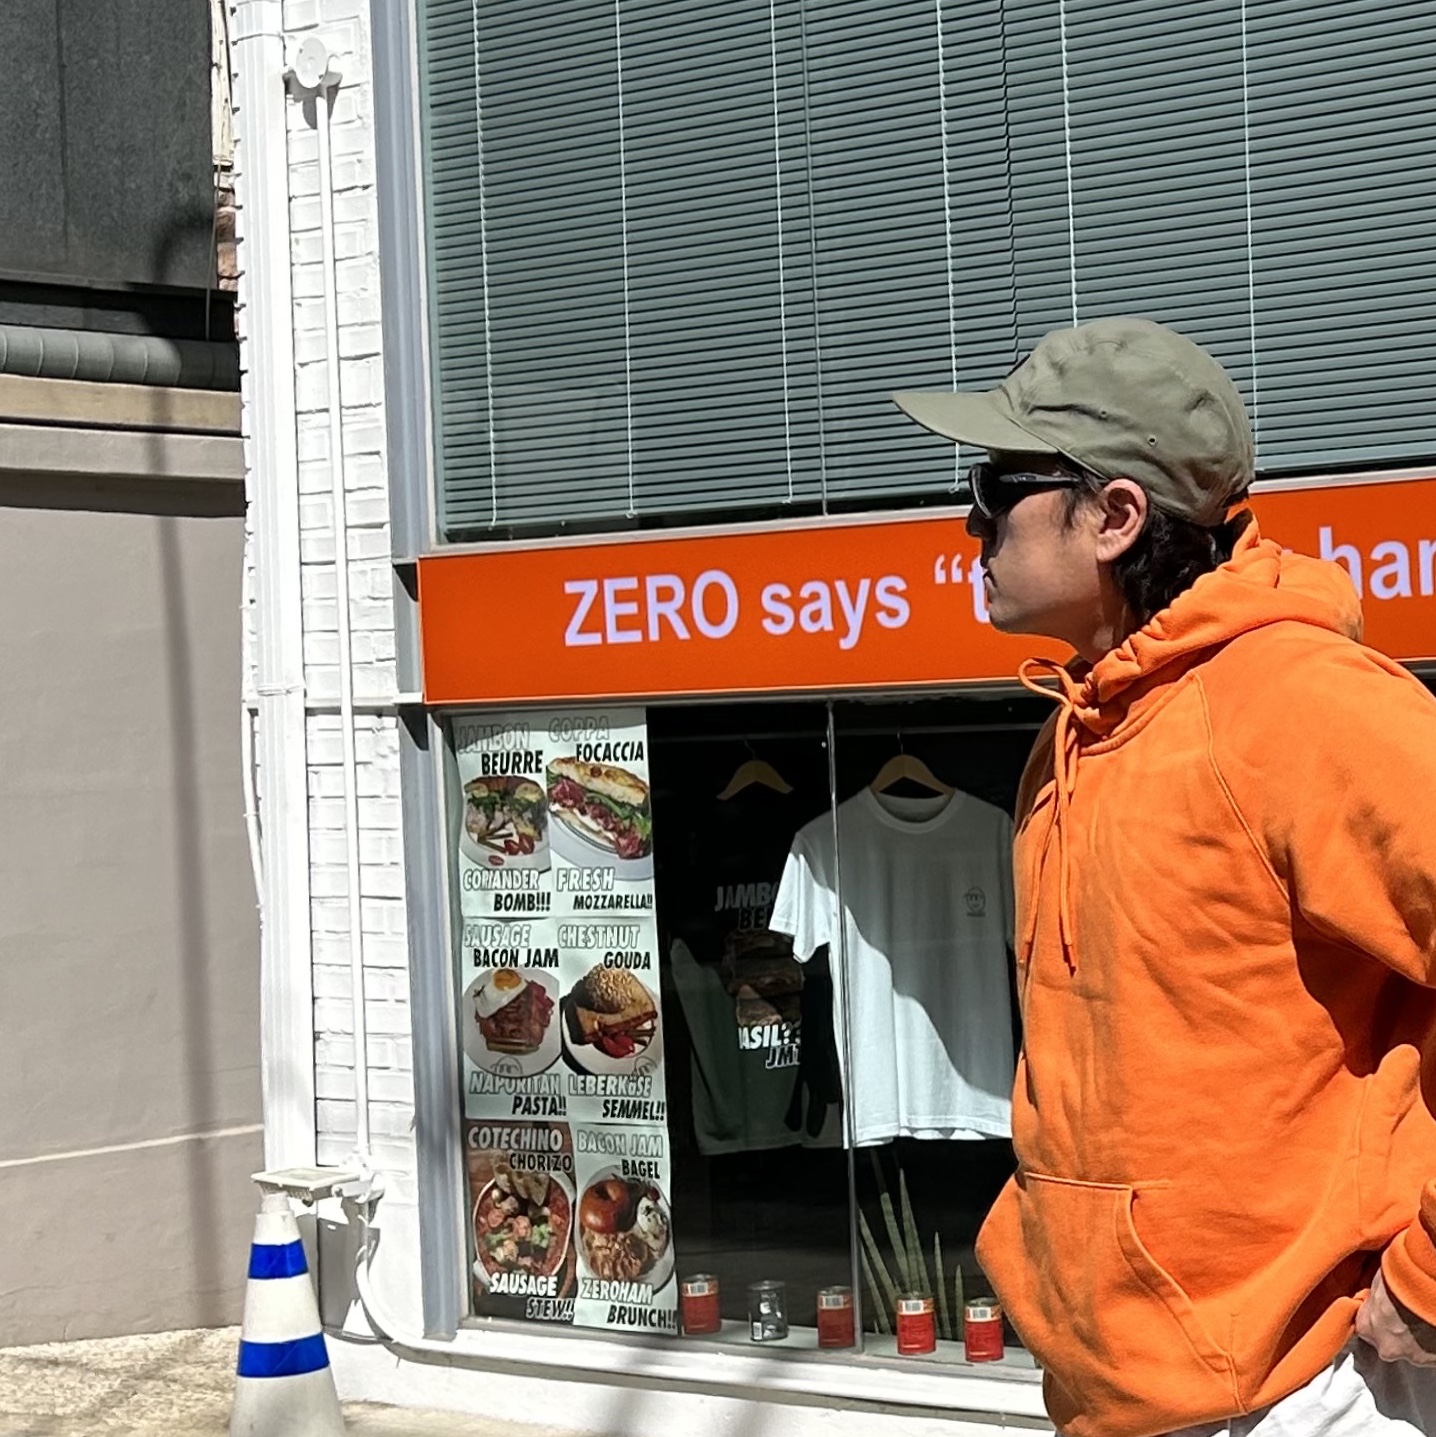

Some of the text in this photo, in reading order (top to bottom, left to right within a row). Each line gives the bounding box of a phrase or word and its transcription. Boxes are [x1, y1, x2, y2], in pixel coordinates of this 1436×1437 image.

[564, 569, 740, 647] ZERO
[760, 573, 911, 650] says
[458, 722, 530, 754] JAMBON
[549, 716, 610, 742] COPPA
[481, 750, 543, 775] BEURRE
[576, 741, 645, 762] FOCACCIA
[463, 867, 540, 891] CORIANDER
[556, 867, 615, 892] FRESH
[493, 892, 551, 912] BOMB!!!
[464, 924, 532, 948] SAUSAGE
[558, 924, 641, 949] CHESTNUT
[473, 948, 560, 968] BACON JAM
[603, 951, 651, 970] GOUDA
[511, 1096, 567, 1116] PASTA!!
[602, 1100, 665, 1121] SEMMEL!!
[468, 1126, 563, 1151] COTECHINO
[577, 1130, 663, 1158] BACON JAM
[509, 1152, 573, 1172] CHORIZO
[621, 1159, 660, 1180] BAGEL
[489, 1272, 558, 1297] SAUSAGE
[580, 1277, 654, 1305] ZEROHAM
[526, 1298, 575, 1321] STEW!!
